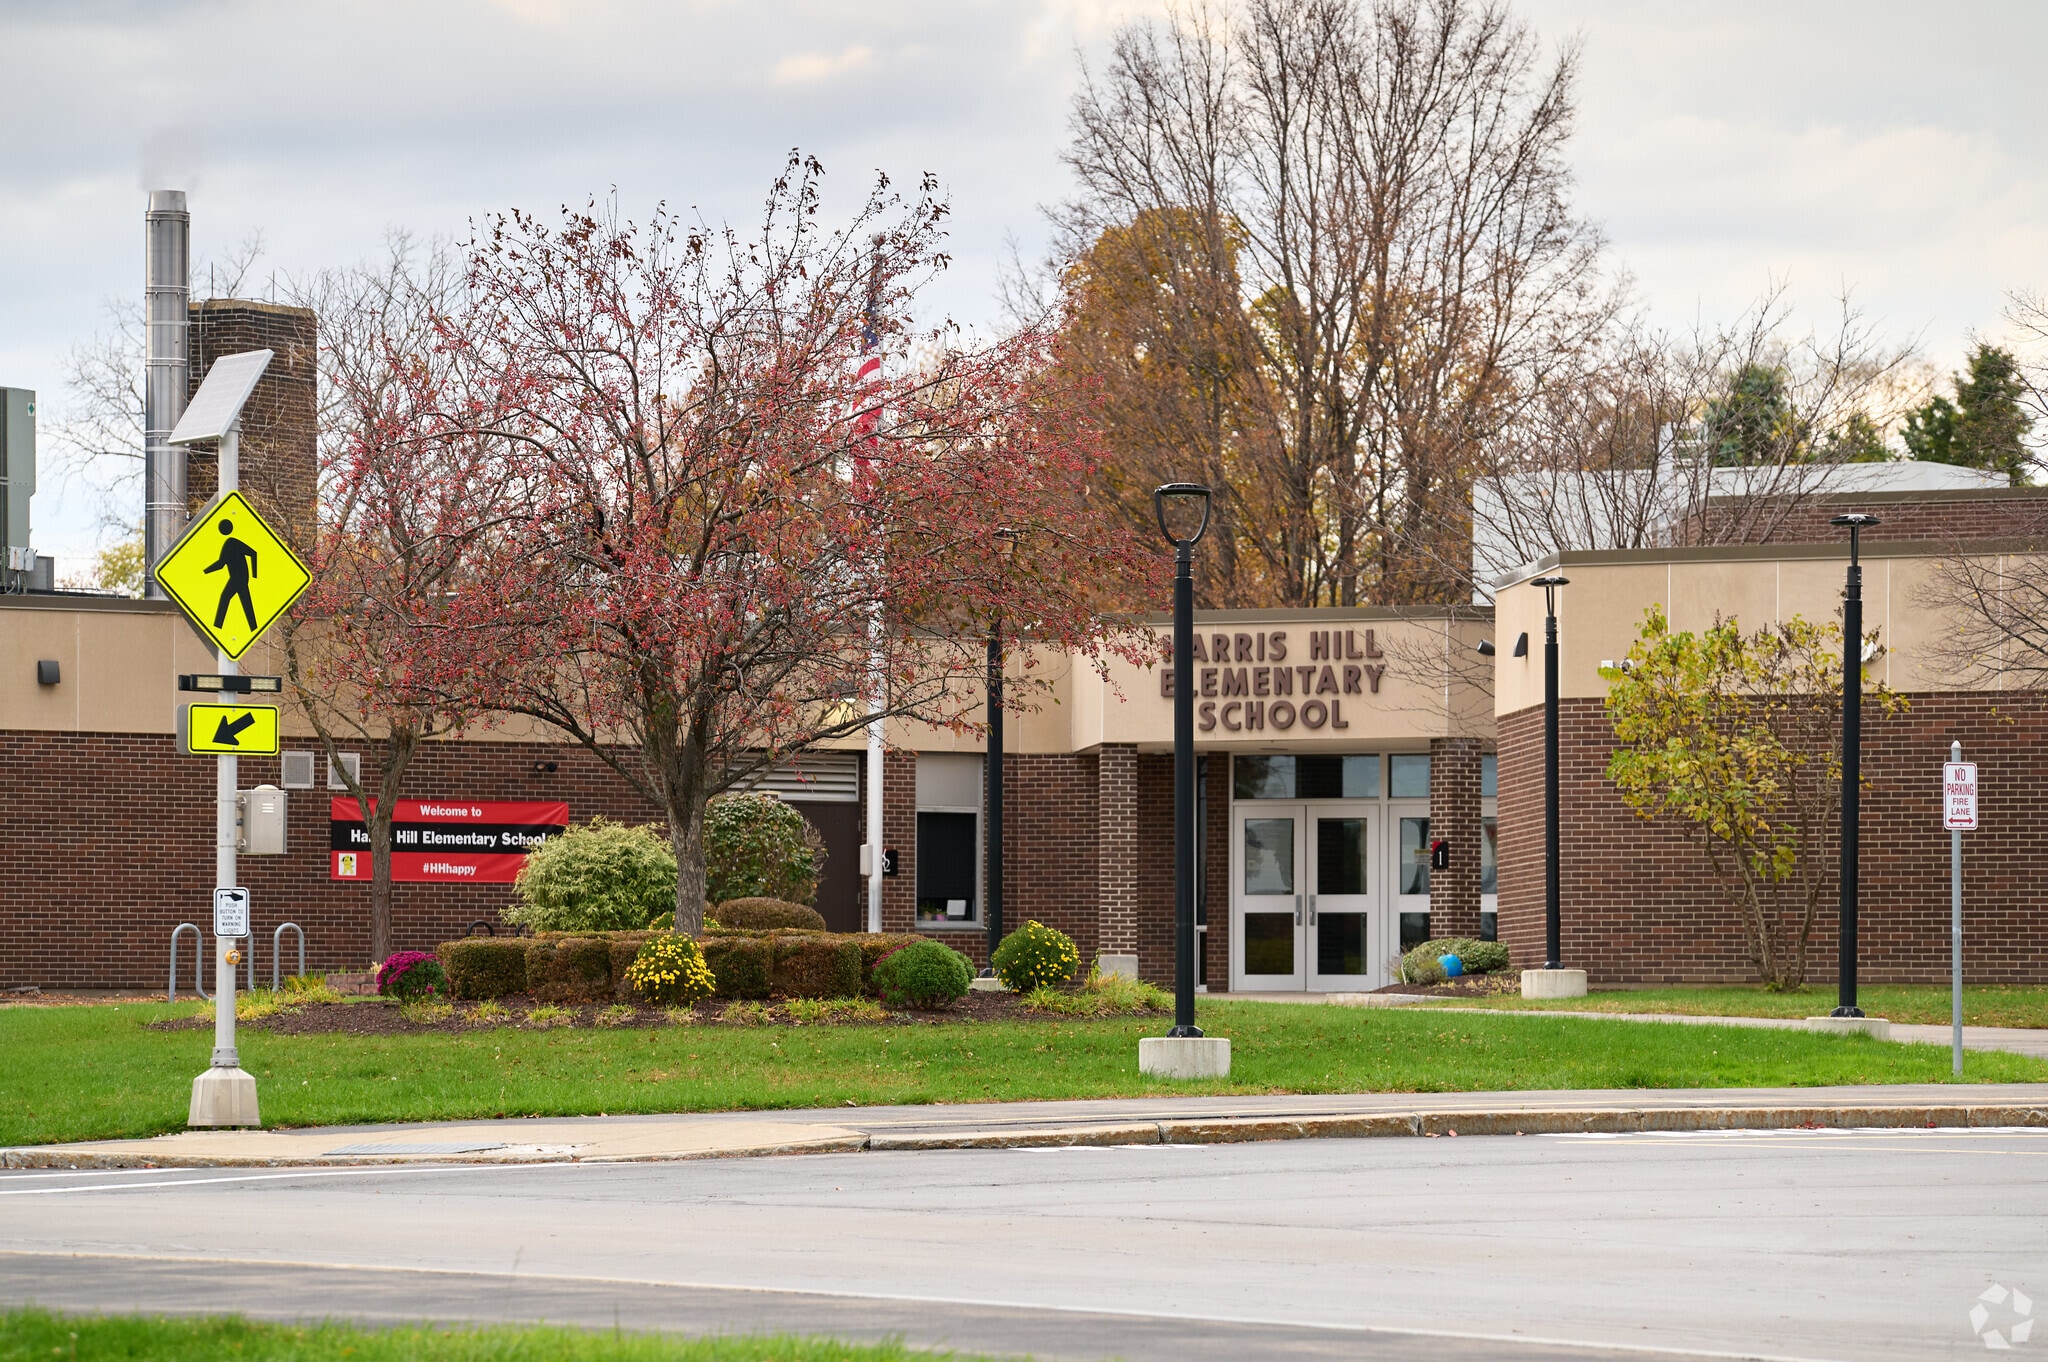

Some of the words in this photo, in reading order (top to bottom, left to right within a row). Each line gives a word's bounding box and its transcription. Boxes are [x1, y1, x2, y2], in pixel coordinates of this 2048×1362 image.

[1310, 629, 1384, 661] HILL
[1161, 664, 1386, 698] EEMENTARY
[1198, 700, 1349, 731] SCHOOL
[1955, 769, 1966, 781] NO
[1947, 783, 1974, 795] PARKING
[420, 805, 468, 817] Welcome
[471, 806, 482, 817] to
[396, 830, 418, 844] Hill
[422, 831, 498, 848] Elementary
[501, 832, 546, 846] School
[423, 863, 477, 876] #HHhappy
